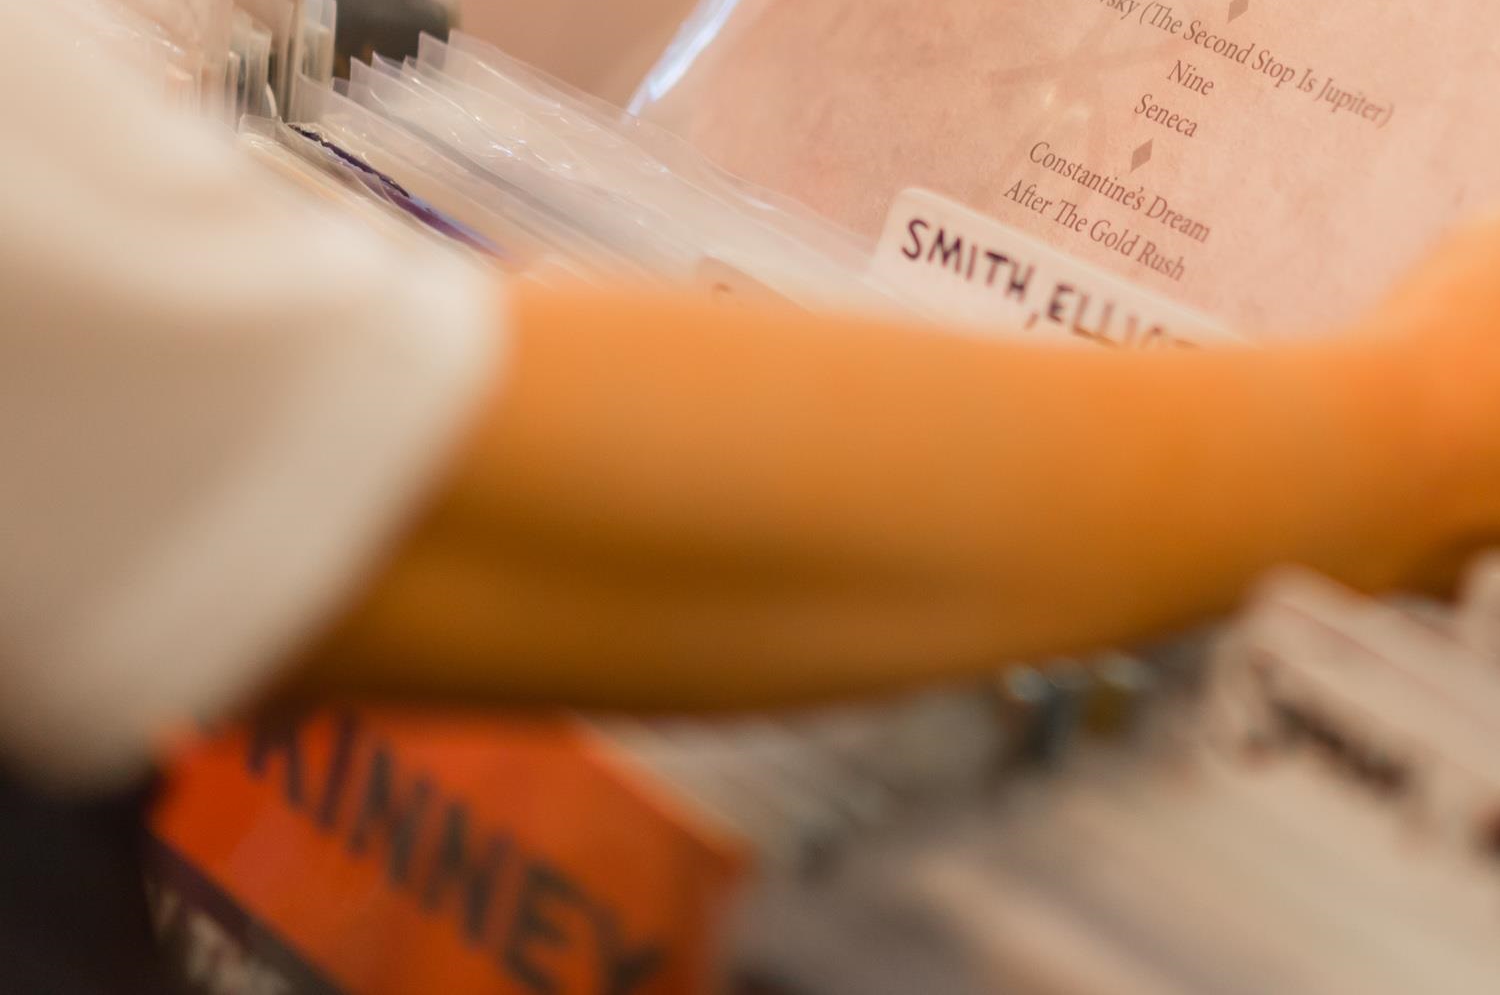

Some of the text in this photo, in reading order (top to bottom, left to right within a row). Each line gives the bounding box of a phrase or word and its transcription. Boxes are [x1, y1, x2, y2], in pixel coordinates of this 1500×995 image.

[1133, 93, 1198, 138] Seneca
[1139, 0, 1183, 35] (The
[1184, 20, 1255, 65] Second
[1251, 49, 1296, 88] Stop
[1295, 67, 1318, 93] Is
[1314, 76, 1396, 129] Jupiter)
[1167, 59, 1215, 96] Nine
[1004, 179, 1186, 282] After The Gold Rush
[1029, 141, 1211, 243] Constantine’s Dream
